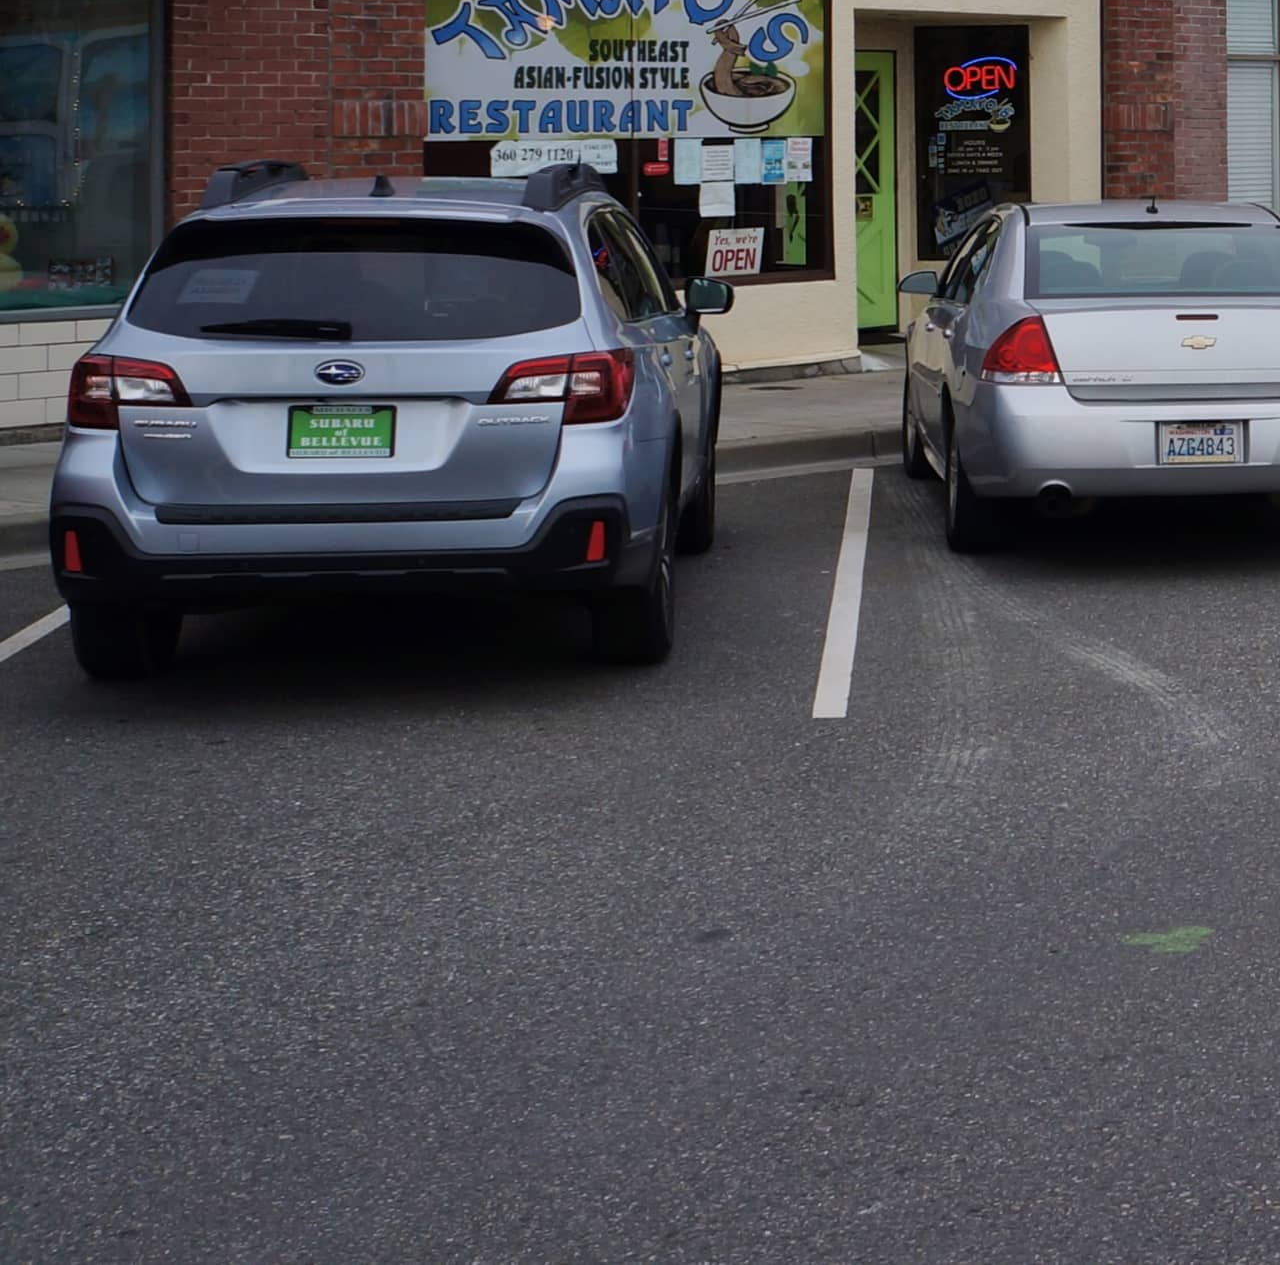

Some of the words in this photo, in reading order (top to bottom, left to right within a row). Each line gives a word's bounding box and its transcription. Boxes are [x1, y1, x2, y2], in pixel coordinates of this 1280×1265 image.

[588, 38, 690, 64] SOUTHEAST
[513, 65, 634, 91] ASIAN-FUSION
[639, 66, 690, 90] STYLE
[943, 65, 1016, 92] OPEN
[429, 98, 694, 134] RESTAURANT
[495, 149, 517, 162] 360
[520, 148, 543, 162] 279
[546, 148, 574, 161] 1120
[713, 235, 731, 246] Yes,
[735, 234, 759, 245] we're
[711, 247, 757, 272] OPEN
[309, 418, 375, 429] SUBARU
[478, 414, 552, 426] OUTBACK
[333, 429, 349, 437] of
[299, 436, 383, 447] BELLEVUE
[1167, 437, 1236, 456] AZG4843
